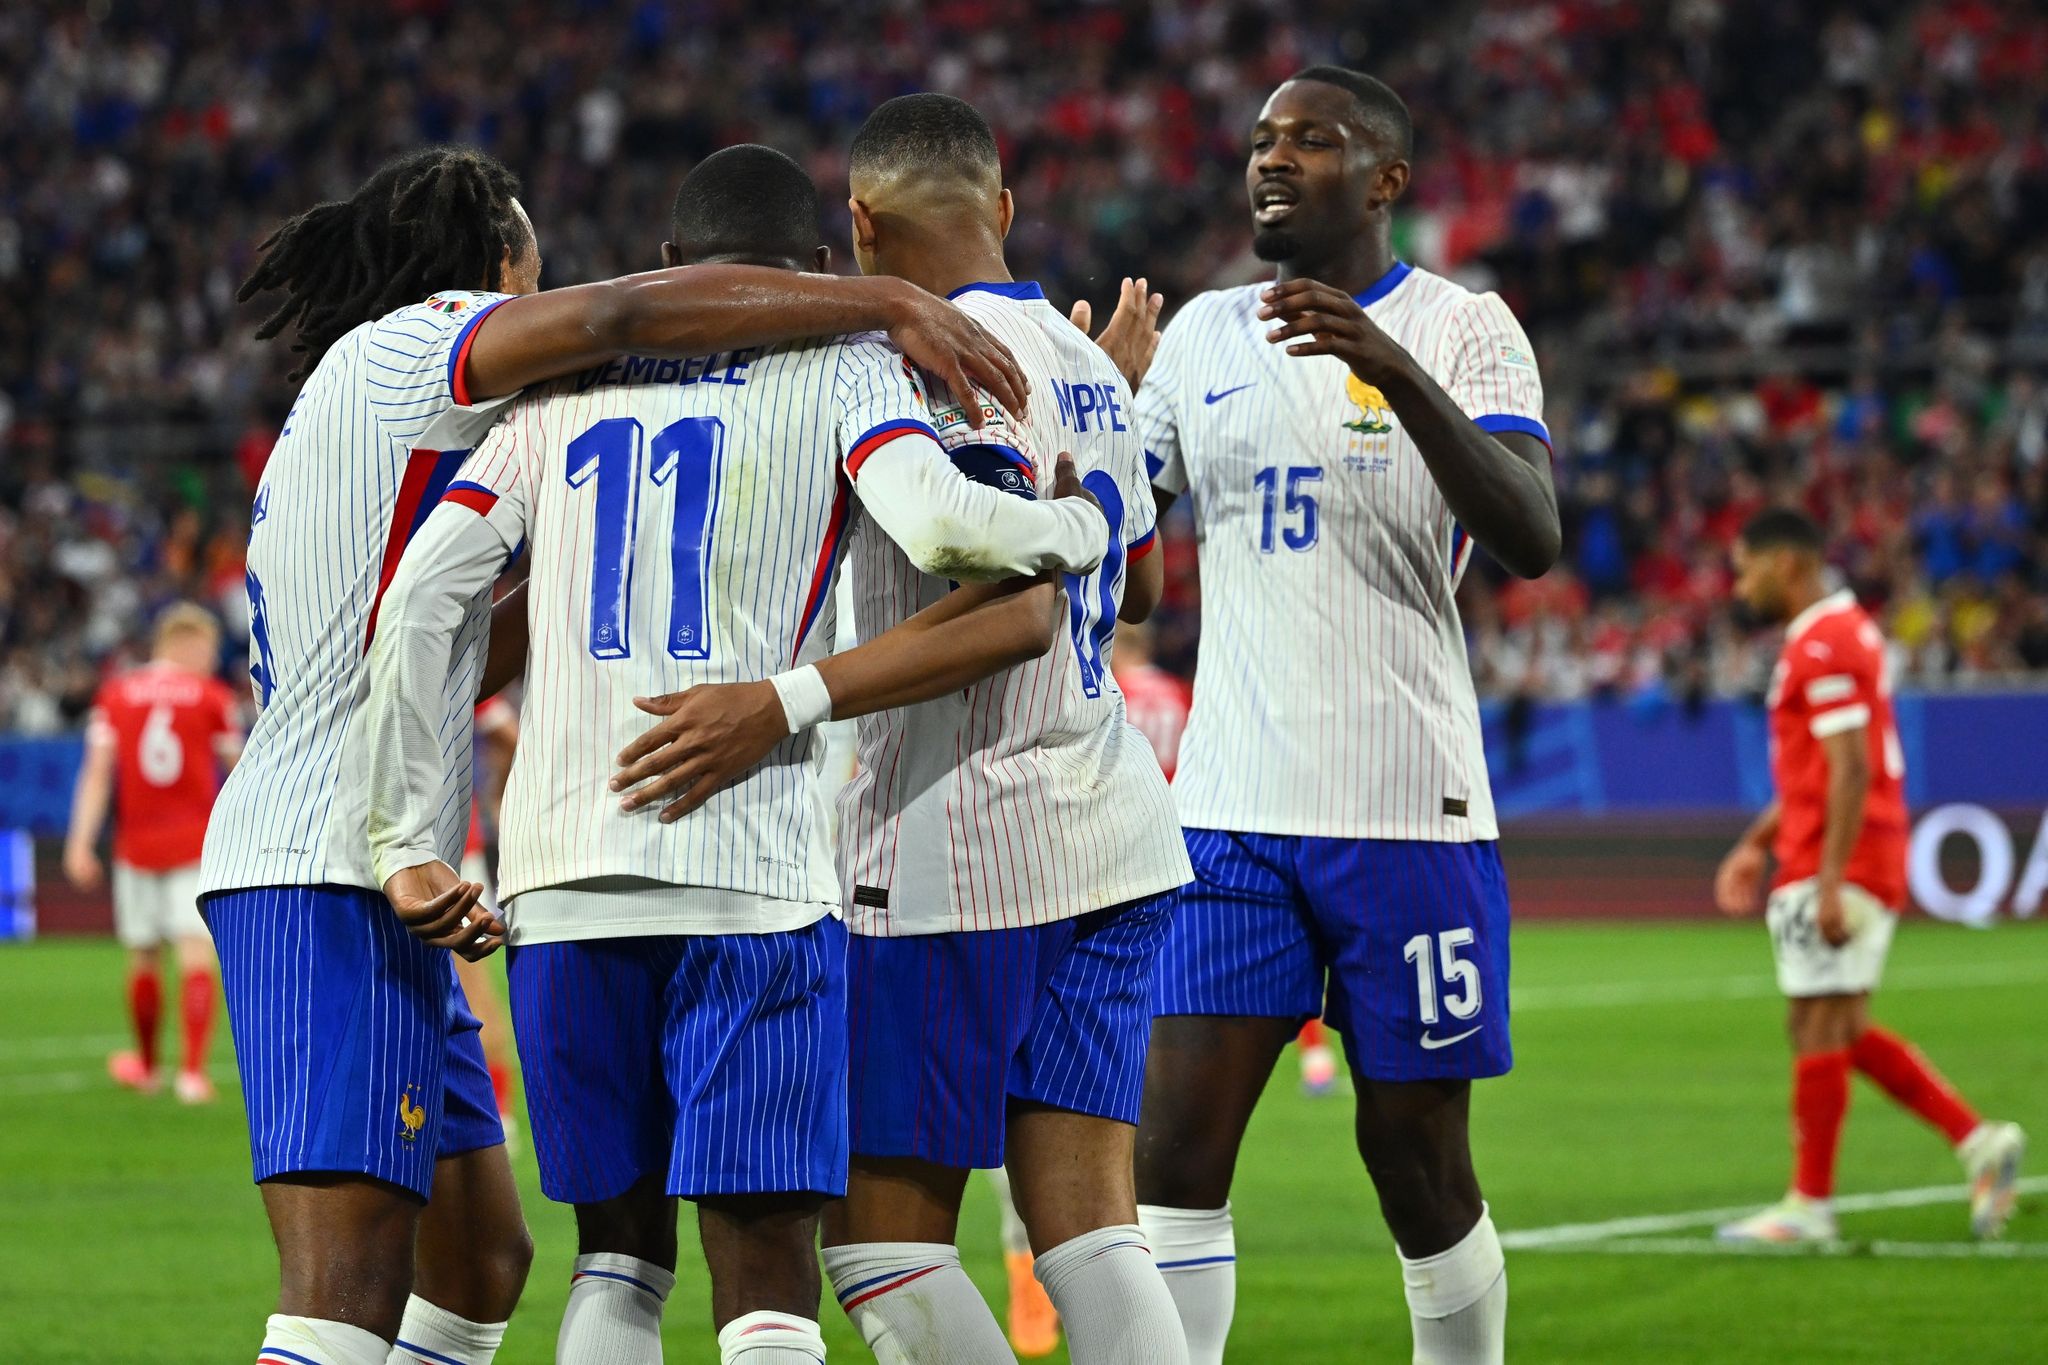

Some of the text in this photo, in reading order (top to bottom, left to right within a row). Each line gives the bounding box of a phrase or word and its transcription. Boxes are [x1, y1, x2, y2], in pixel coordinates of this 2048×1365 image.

[565, 416, 726, 661] 11
[1254, 466, 1323, 554] 15
[138, 704, 185, 788] 6
[1403, 926, 1483, 1025] 15
